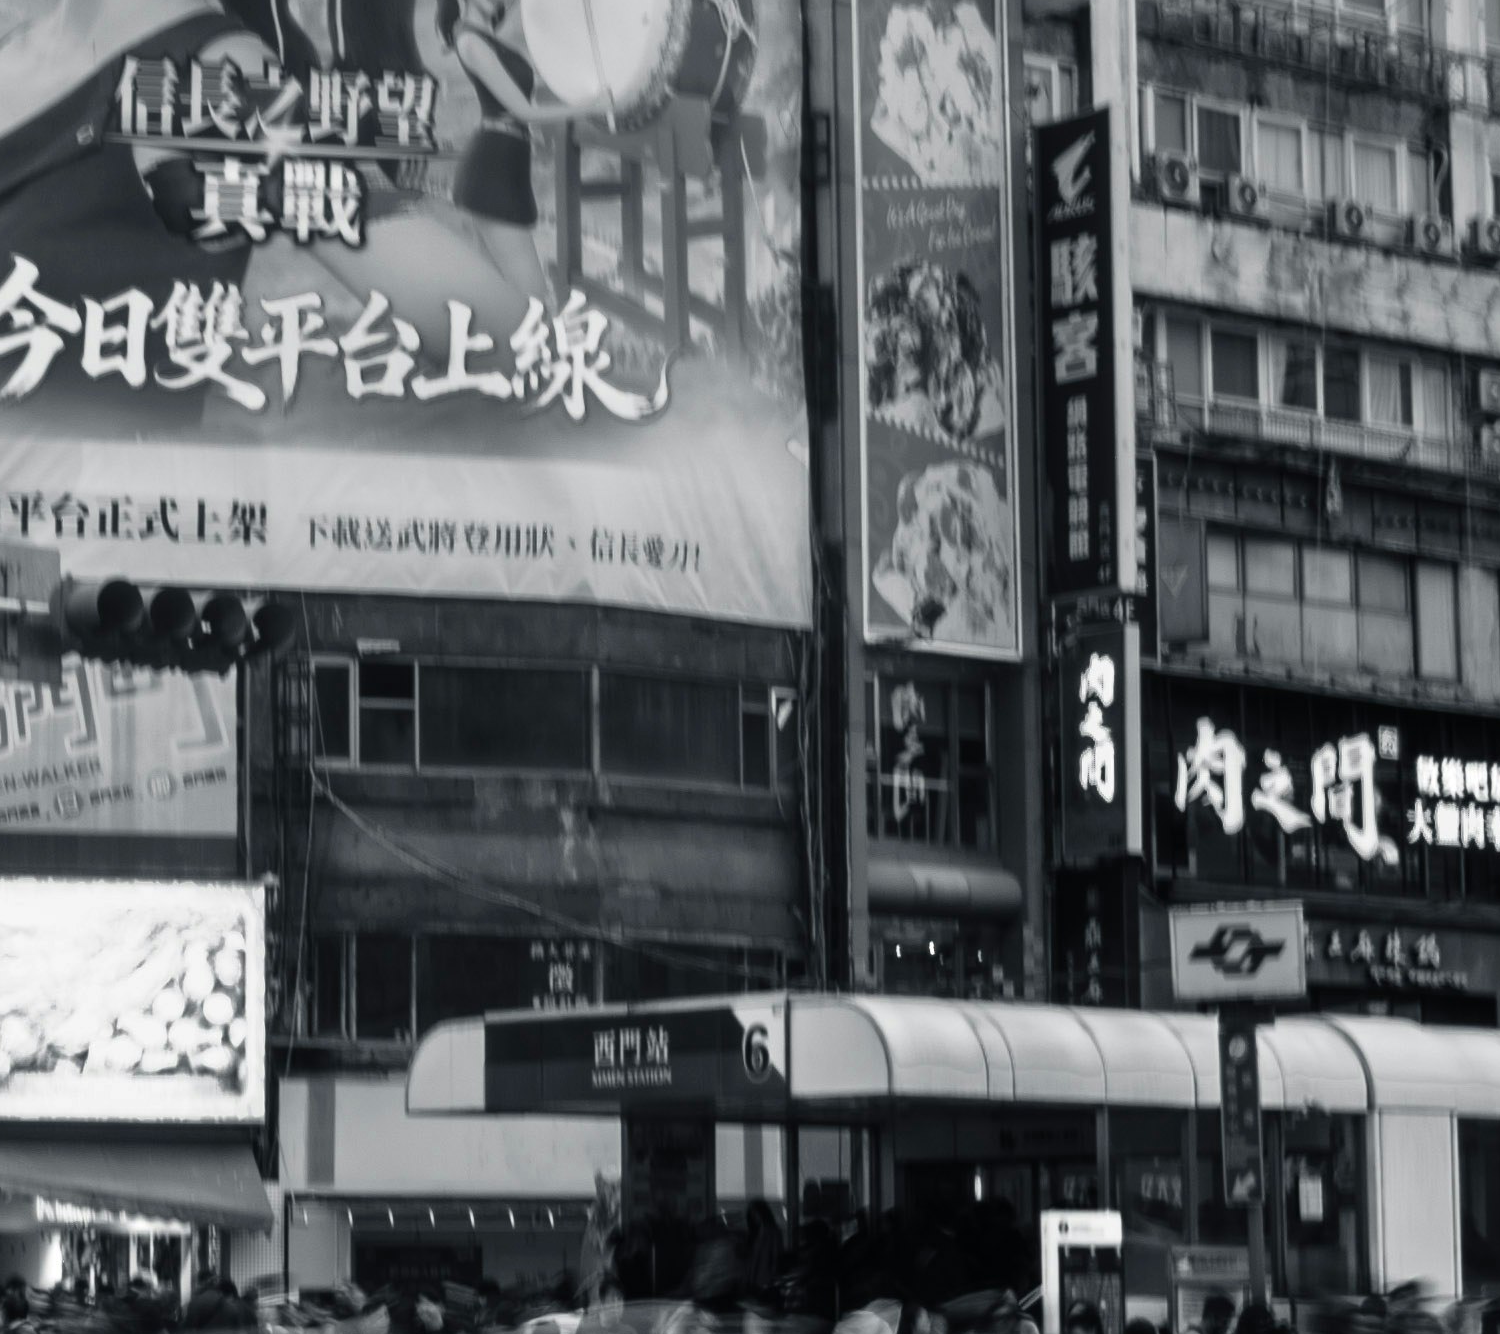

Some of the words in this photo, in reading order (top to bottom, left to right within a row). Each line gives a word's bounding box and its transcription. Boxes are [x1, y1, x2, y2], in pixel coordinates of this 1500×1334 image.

[592, 1024, 670, 1068] 西門站
[742, 1021, 771, 1084] 6
